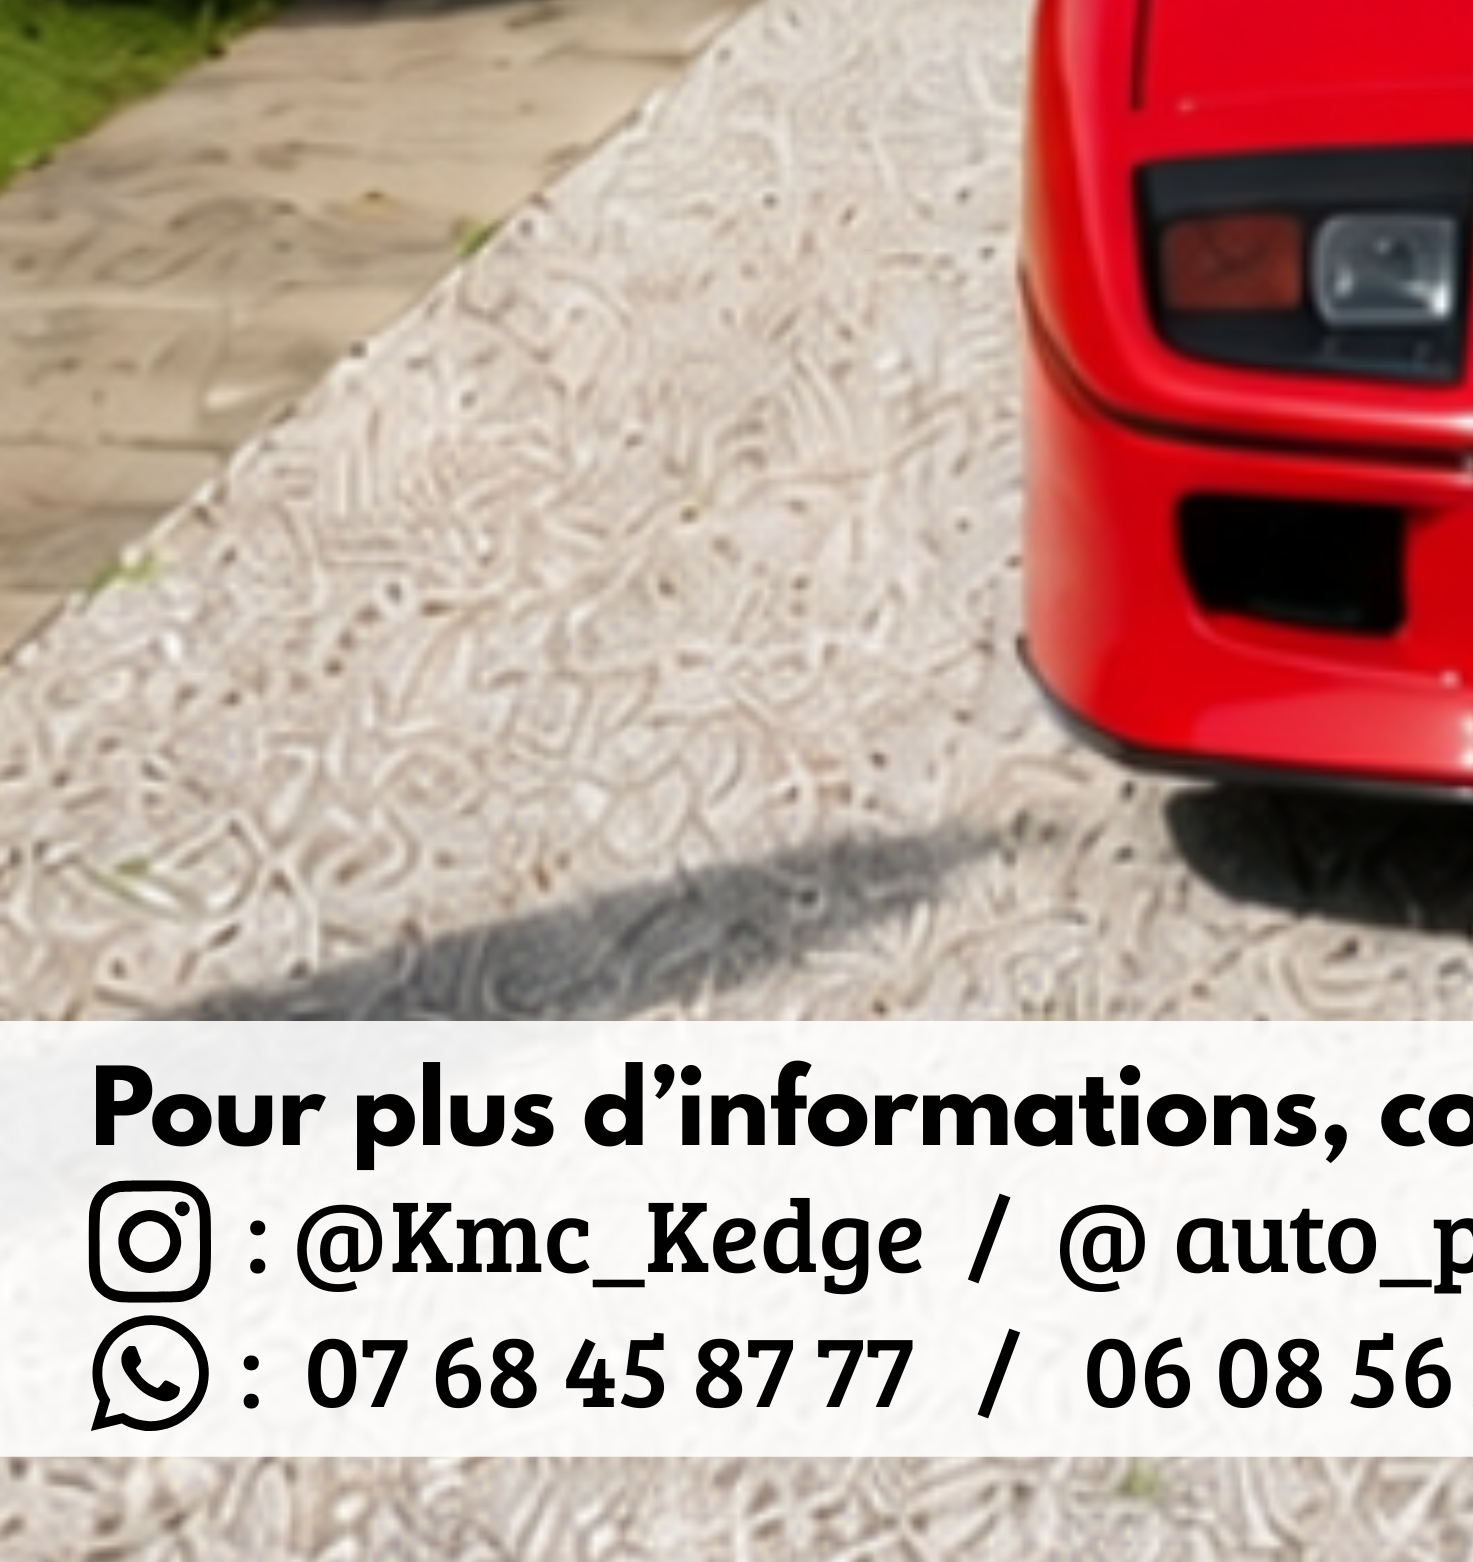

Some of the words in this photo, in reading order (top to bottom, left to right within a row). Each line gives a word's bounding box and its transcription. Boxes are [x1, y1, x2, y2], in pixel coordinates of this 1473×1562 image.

[95, 1064, 327, 1147] Pour
[356, 1061, 554, 1169] plus
[249, 1220, 266, 1274] :
[296, 1197, 922, 1295] @Kmc_Kedge
[967, 1193, 1011, 1284] /
[1059, 1204, 1146, 1293] @
[243, 1355, 260, 1409] :
[307, 1338, 408, 1409] 07
[435, 1336, 538, 1409] 68
[565, 1332, 665, 1409] 45
[695, 1338, 794, 1409] 87
[817, 1339, 913, 1408] 77
[977, 1328, 1021, 1419] /
[1086, 1336, 1191, 1409] 06
[1218, 1338, 1323, 1409] 08
[1350, 1332, 1452, 1409] 56
